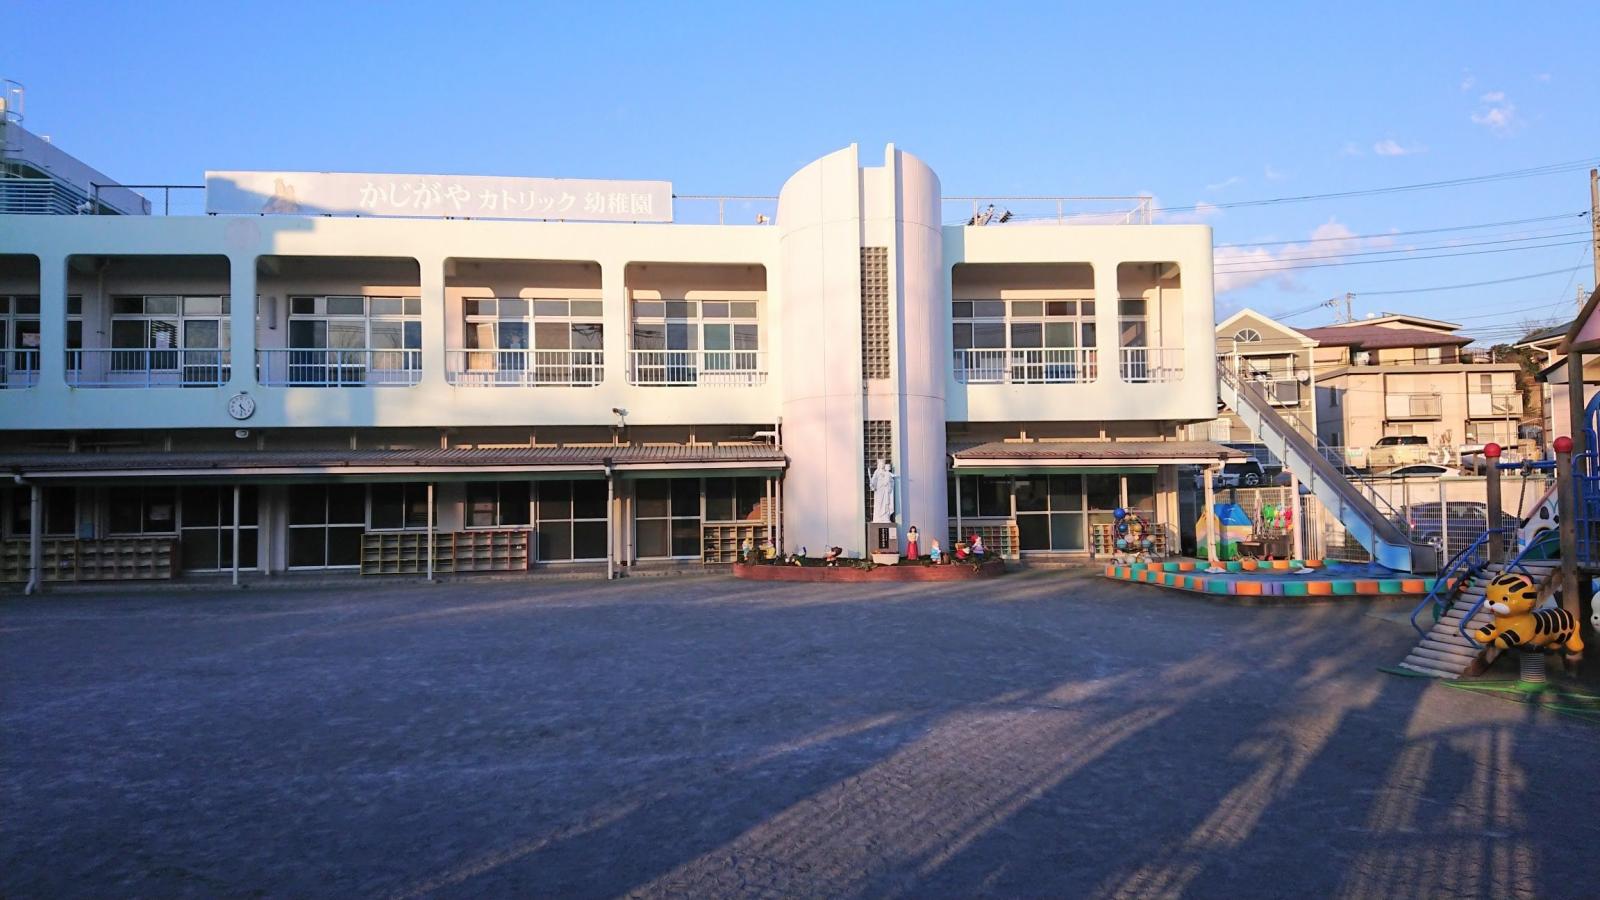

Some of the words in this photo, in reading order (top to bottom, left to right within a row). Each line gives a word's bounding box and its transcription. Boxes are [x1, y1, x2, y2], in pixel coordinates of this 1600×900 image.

[359, 180, 471, 210] かじがや
[478, 188, 577, 213] カトリック
[583, 191, 652, 214] 幼稚園
